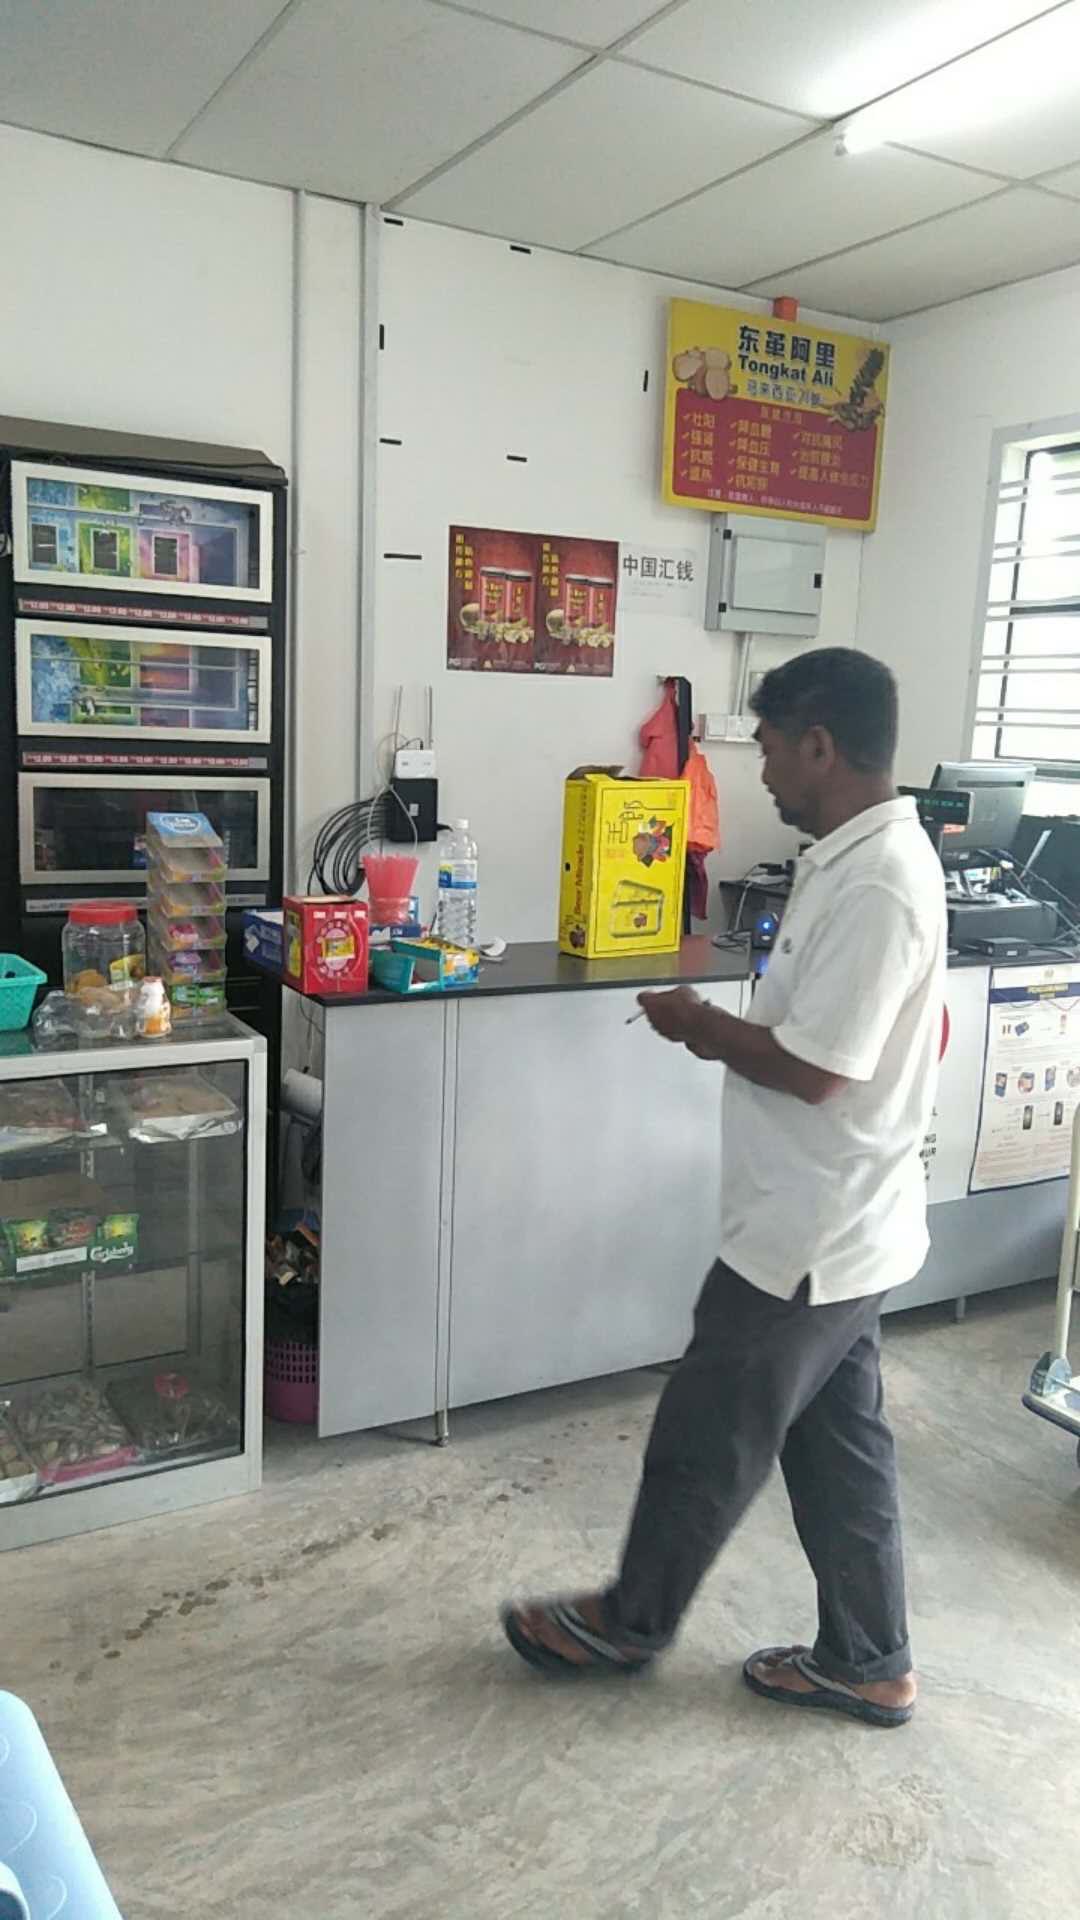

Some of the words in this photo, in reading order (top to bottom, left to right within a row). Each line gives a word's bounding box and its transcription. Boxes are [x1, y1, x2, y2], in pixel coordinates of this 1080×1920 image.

[738, 326, 834, 369] 东革阿里
[738, 354, 807, 383] Tongkat
[812, 369, 834, 387] Ali
